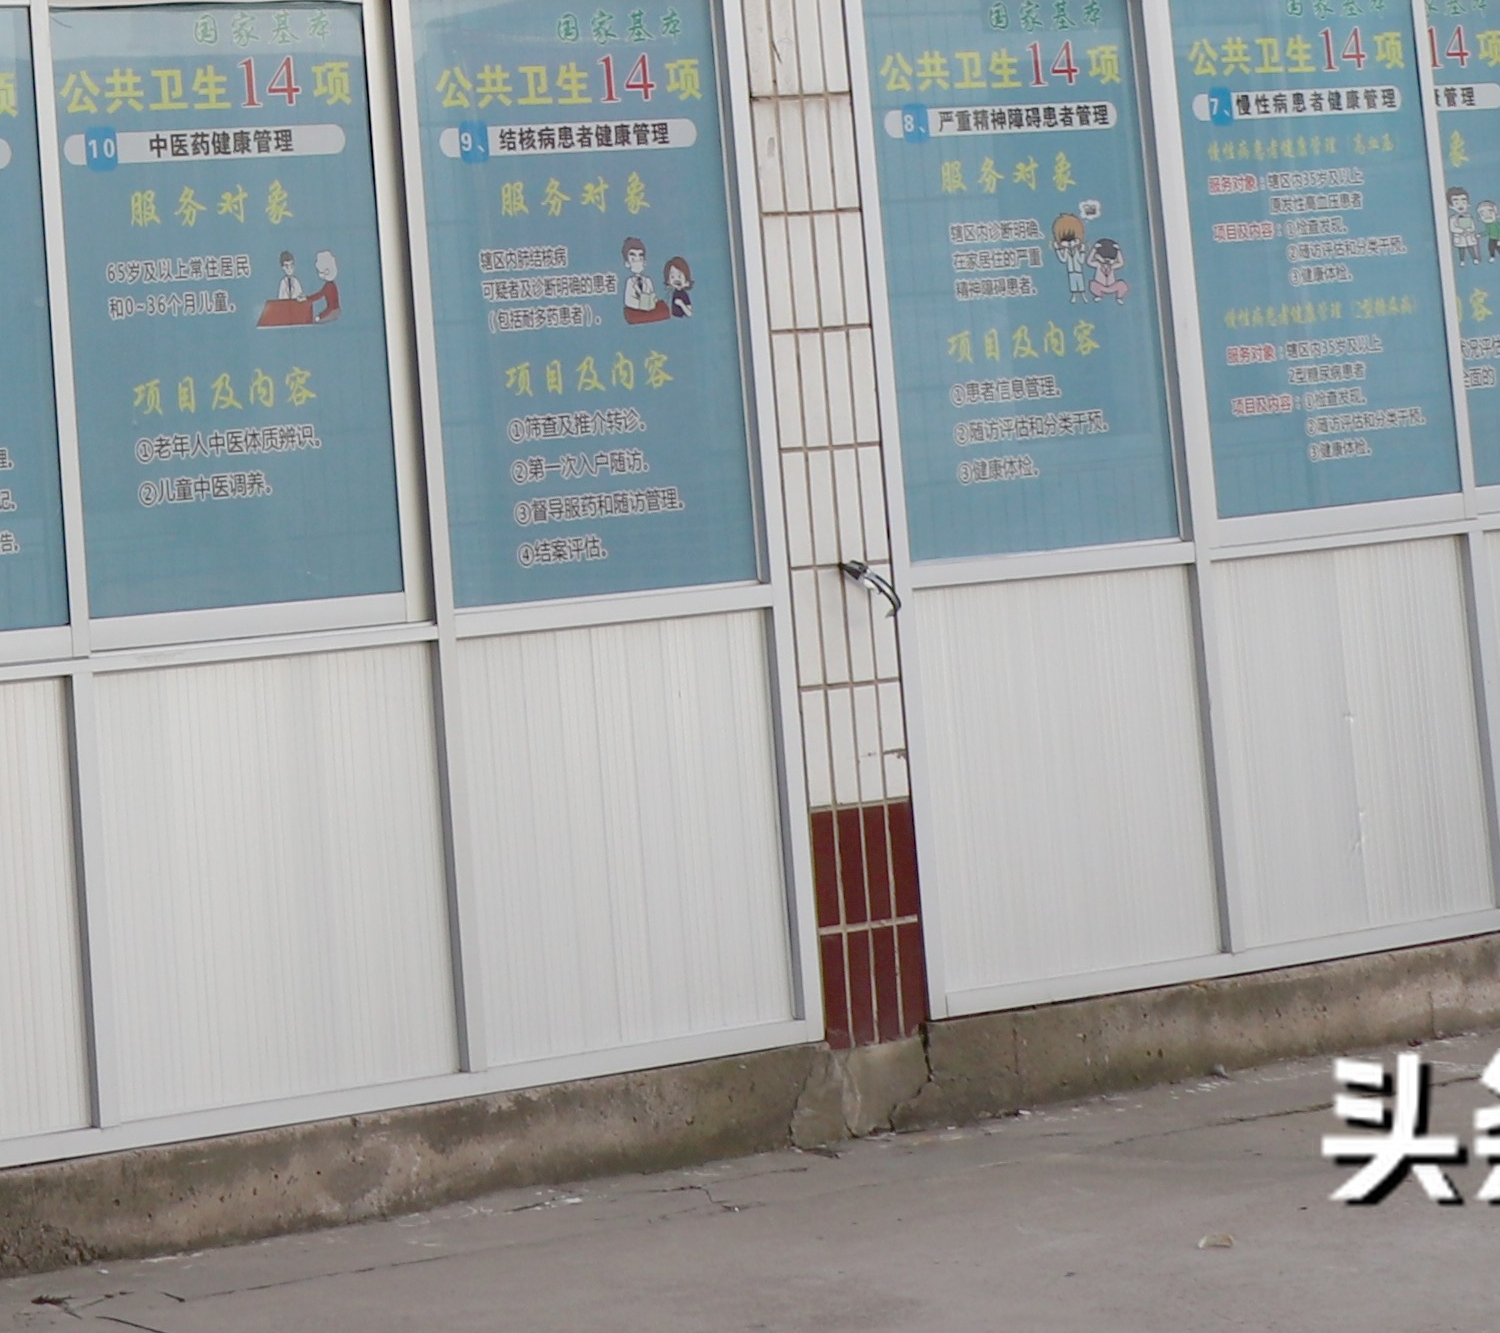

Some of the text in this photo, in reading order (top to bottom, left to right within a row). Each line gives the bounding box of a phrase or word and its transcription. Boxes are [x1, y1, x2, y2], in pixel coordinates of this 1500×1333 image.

[192, 9, 331, 46] 国家基本
[556, 7, 683, 44] 国家基本
[880, 39, 1122, 92] 公共卫生14项
[1188, 25, 1405, 76] 公共卫生14项
[60, 55, 351, 116] 公共卫生14项
[436, 52, 703, 109] 公共卫生14项
[1236, 88, 1397, 116] 慢性病患者健康管理
[498, 121, 670, 151] 结核病患者健康管理
[938, 105, 1109, 133] 严重精神障碍患者管理
[87, 130, 294, 158] 10 中医药健康管理
[940, 152, 1077, 193] 服务对象
[131, 179, 294, 227] 服务对象
[500, 172, 650, 217] 服务对象
[106, 254, 250, 285] 65岁及以上常住居民
[947, 320, 1100, 363] 项目及内容
[134, 366, 317, 416] 项目及内容
[505, 350, 675, 397] 项目及内容
